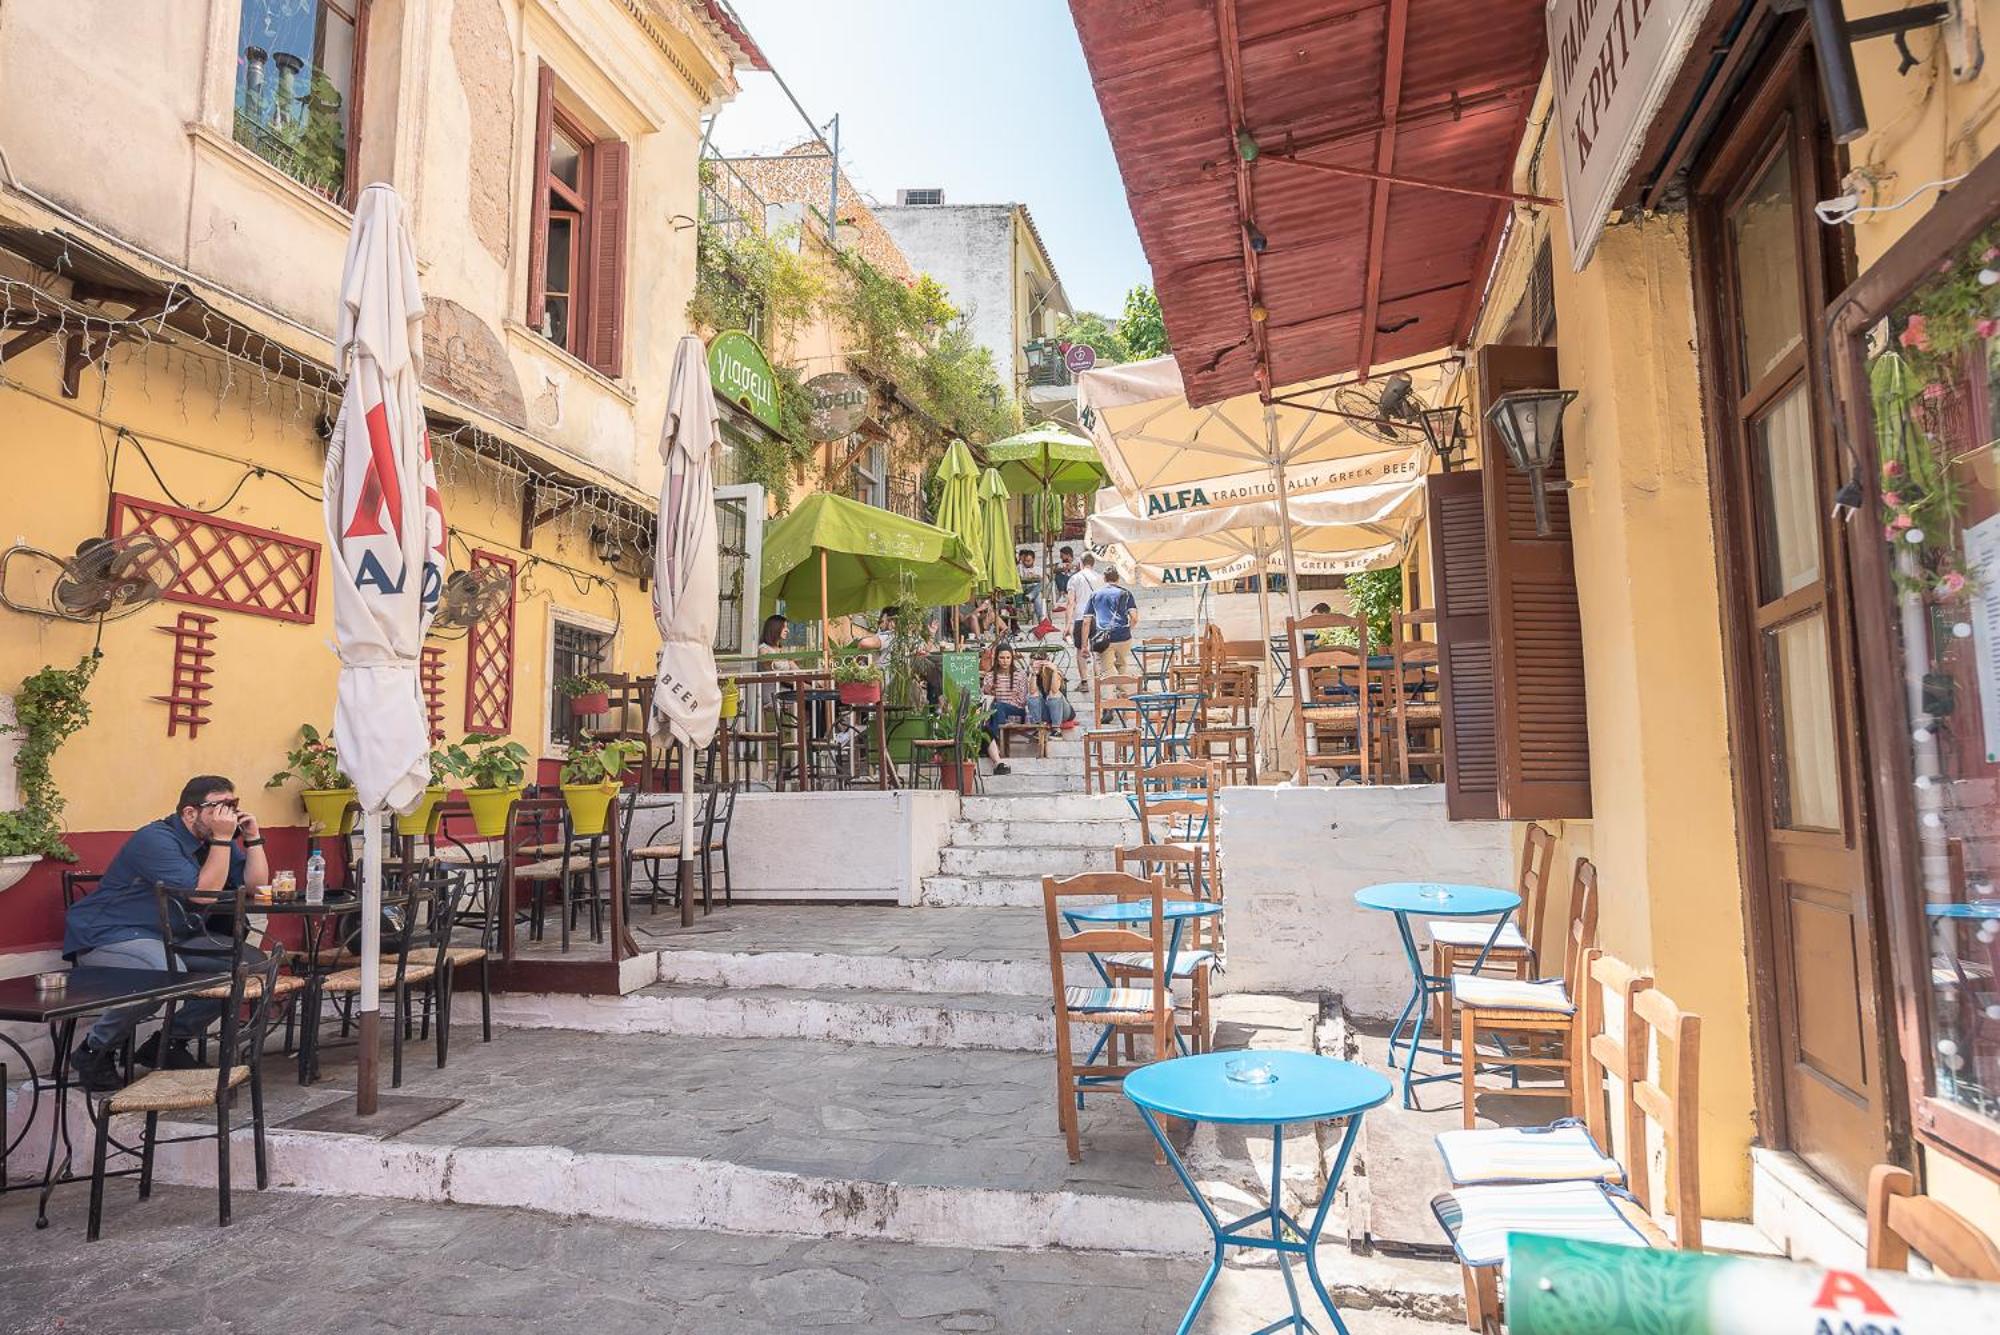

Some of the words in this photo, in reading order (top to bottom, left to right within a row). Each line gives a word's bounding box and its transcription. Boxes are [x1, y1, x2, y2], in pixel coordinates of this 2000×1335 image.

[1575, 0, 1651, 174] ΚΡΗΤΙ
[1147, 487, 1210, 517] ALFA
[1212, 477, 1319, 501] TRADITIOALLY
[1328, 468, 1373, 484] GREEK
[1383, 462, 1416, 475] BEER
[1162, 565, 1213, 583] ALFA
[1301, 560, 1336, 569] GREEK
[660, 673, 698, 713] BEER
